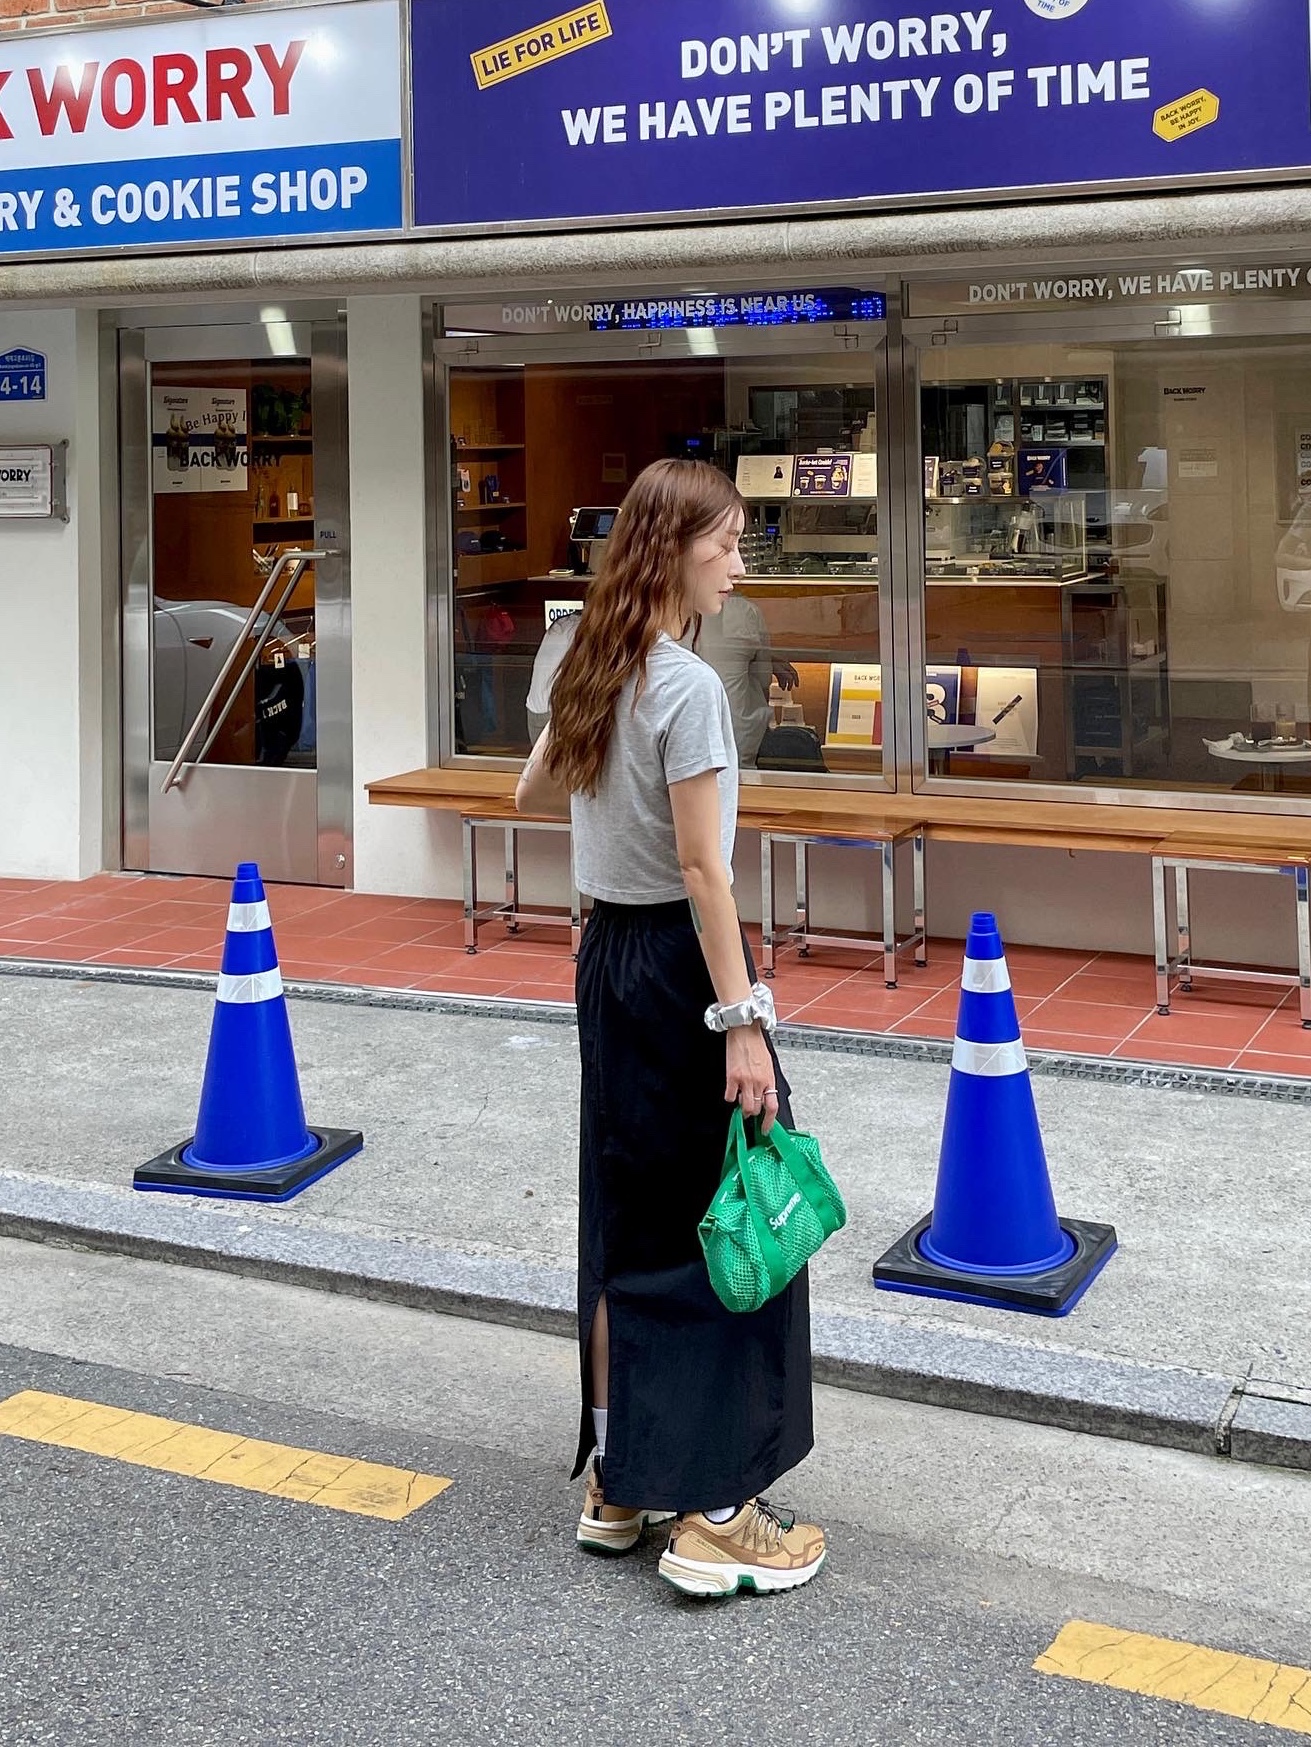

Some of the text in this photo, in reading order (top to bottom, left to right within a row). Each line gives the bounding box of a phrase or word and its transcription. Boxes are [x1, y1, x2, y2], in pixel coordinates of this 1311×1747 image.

[1037, 0, 1055, 12] TIME
[481, 12, 601, 76] LIE FOR LIFE
[680, 9, 1008, 79] DON'T WORRY,
[26, 40, 307, 136] WORRY
[561, 56, 1150, 146] WE HAVE PLENTY OF TIME
[1160, 108, 1179, 122] BACK
[1170, 106, 1202, 126] BE HAPPY
[53, 187, 82, 228] &
[91, 174, 241, 226] COOKIE
[251, 166, 368, 215] SHOP
[969, 282, 1028, 302] DON'T
[1032, 277, 1113, 300] WORRY,
[1118, 275, 1151, 295] WE
[1157, 270, 1214, 293] HAVE
[1220, 267, 1301, 290] PLENTY
[502, 306, 550, 324] DON'T
[554, 303, 620, 324] WORRY,
[624, 298, 715, 320] HAPPINESS
[720, 298, 736, 315] IS
[741, 294, 788, 314] NEAR
[185, 420, 200, 432] Be
[202, 411, 239, 426] Happy
[180, 451, 281, 467] BACK WORRY
[0, 469, 31, 482] ORRY
[320, 531, 337, 539] PULL
[769, 1192, 801, 1230] Supreme
